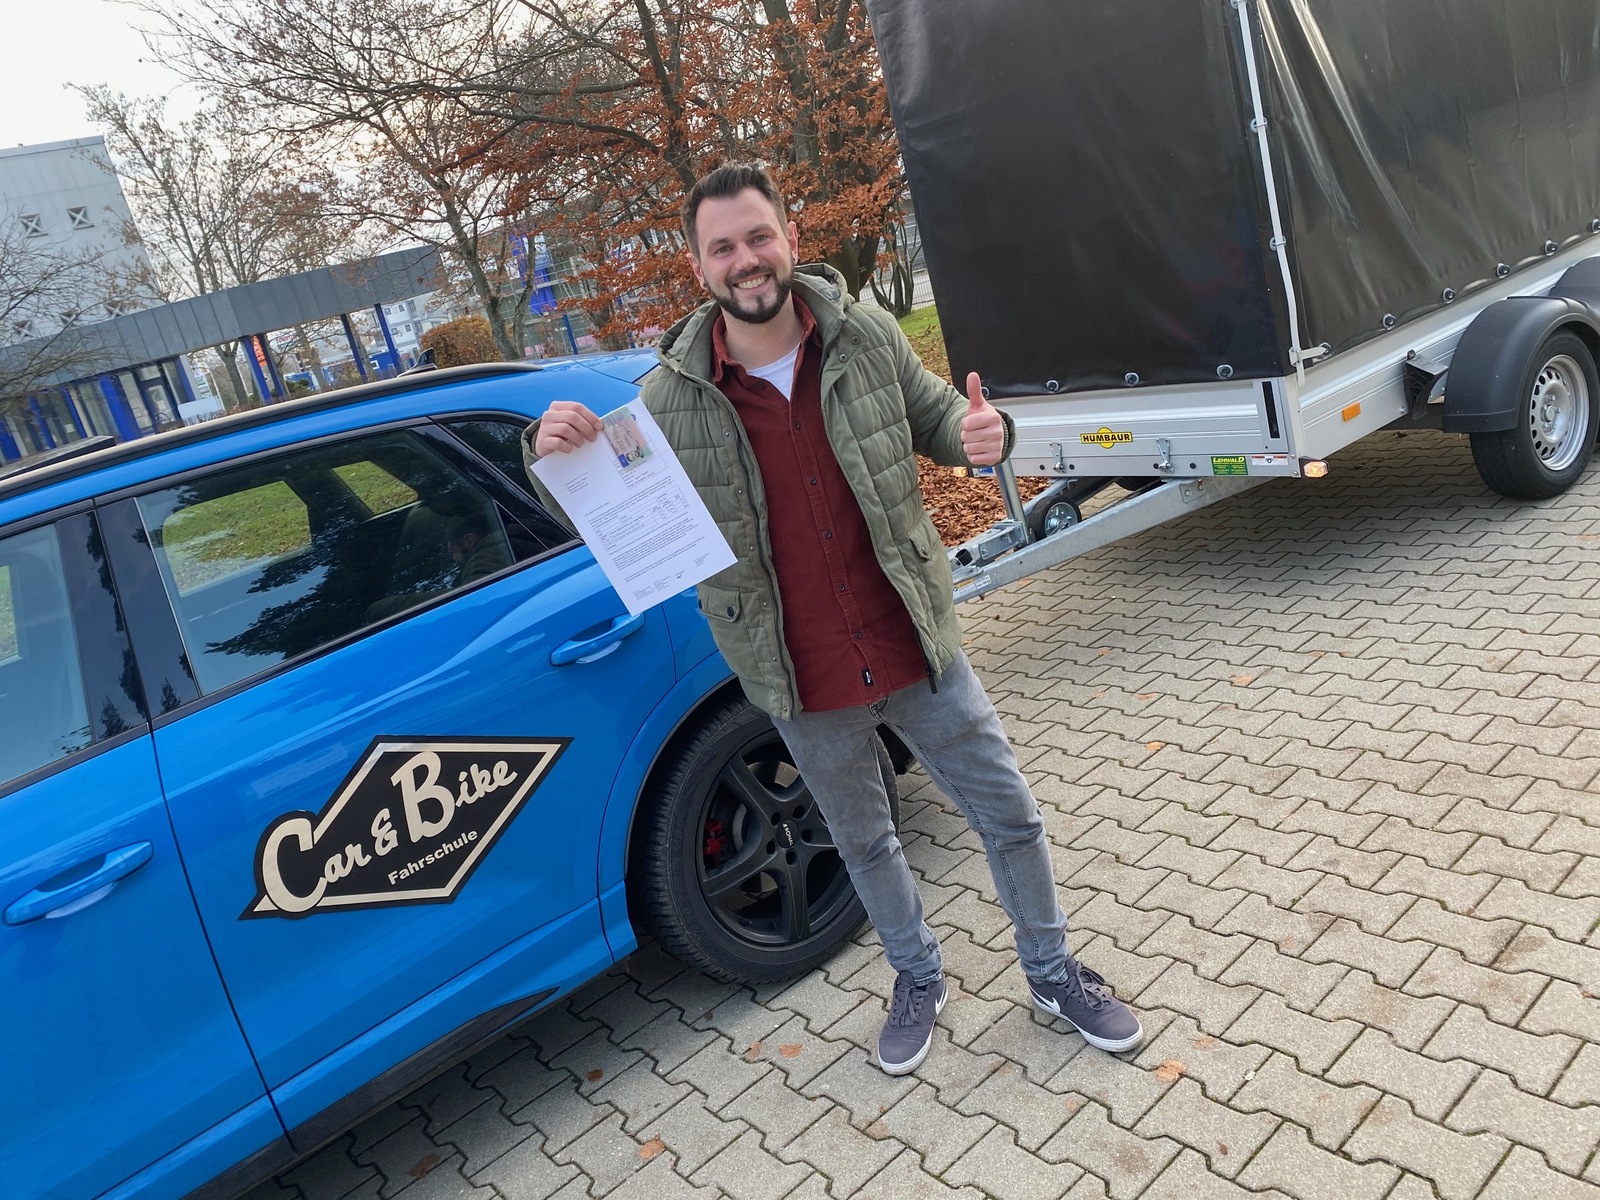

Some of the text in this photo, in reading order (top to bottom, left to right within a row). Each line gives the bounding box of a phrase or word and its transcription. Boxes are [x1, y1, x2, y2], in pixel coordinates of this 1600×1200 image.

[1082, 433, 1131, 443] HUMBAUR
[262, 751, 518, 913] Car & Bike
[387, 829, 479, 886] Fahrschule
